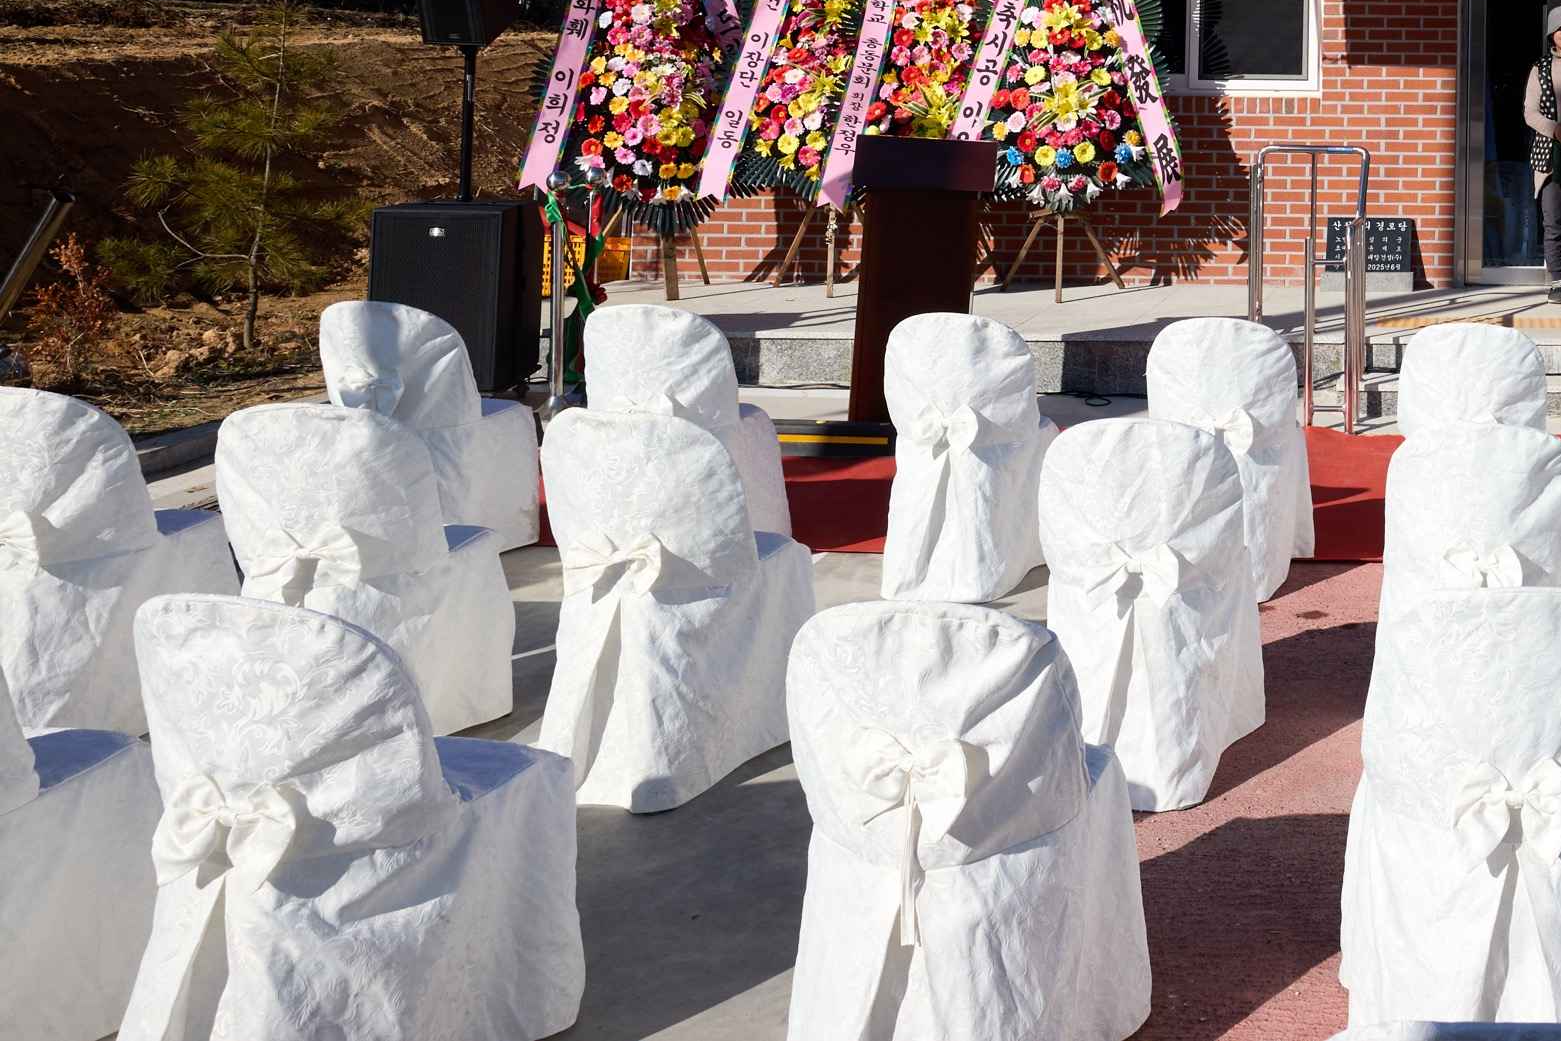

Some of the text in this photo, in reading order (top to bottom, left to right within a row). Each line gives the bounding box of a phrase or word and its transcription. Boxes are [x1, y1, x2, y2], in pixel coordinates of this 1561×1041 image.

[739, 32, 769, 89] 이장단
[537, 62, 575, 144] 이희정
[717, 110, 744, 150] 일동
